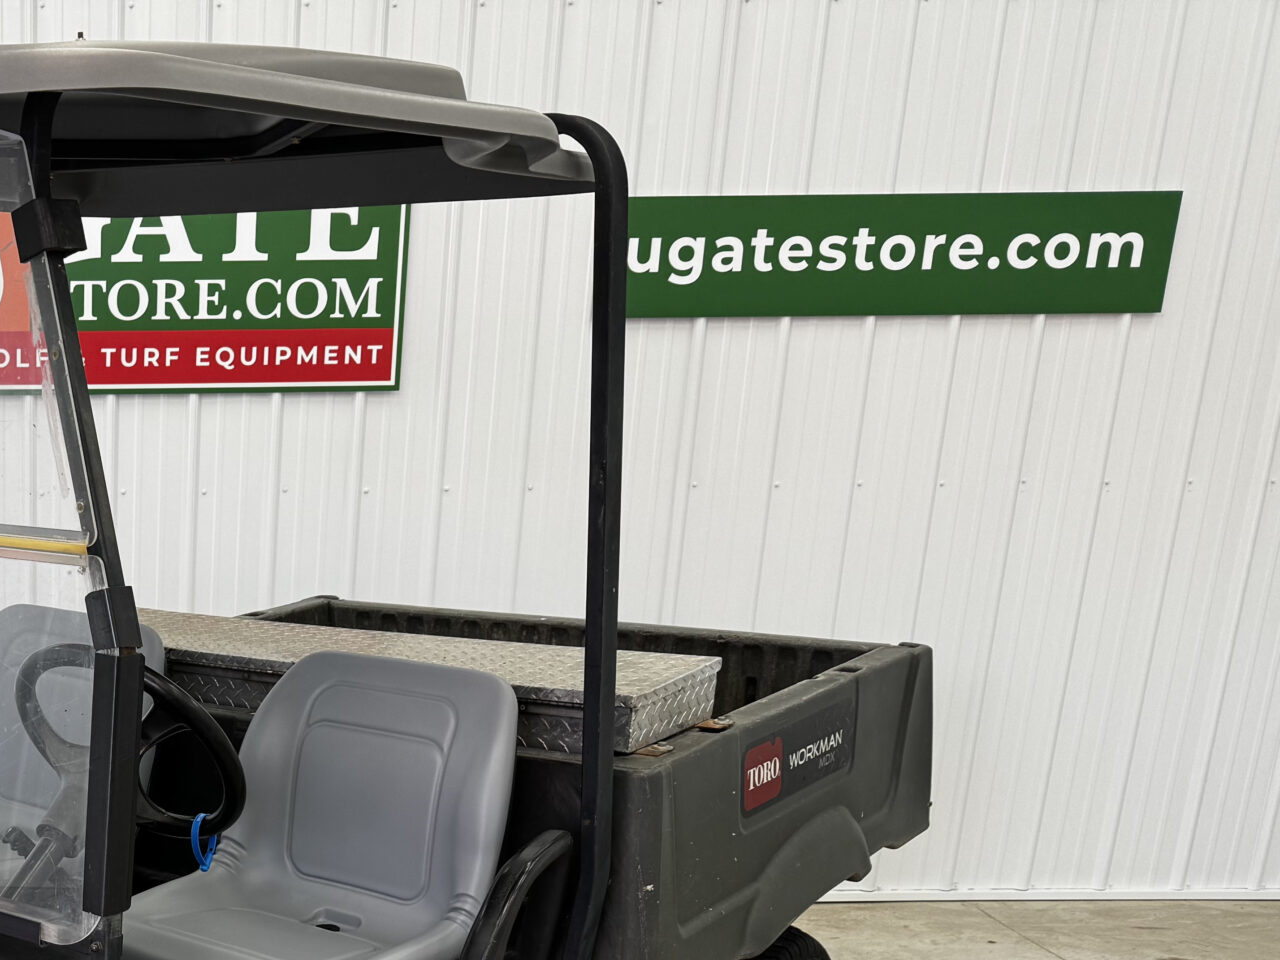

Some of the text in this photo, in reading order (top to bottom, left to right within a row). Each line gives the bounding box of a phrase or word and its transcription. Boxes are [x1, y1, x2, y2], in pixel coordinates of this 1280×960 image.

[626, 227, 1145, 285] ugatestore.com
[70, 277, 384, 321] TORE.COM
[100, 347, 180, 367] TURF
[195, 344, 383, 370] EQUIPMENT
[747, 729, 843, 791] TORO WORKMAN
